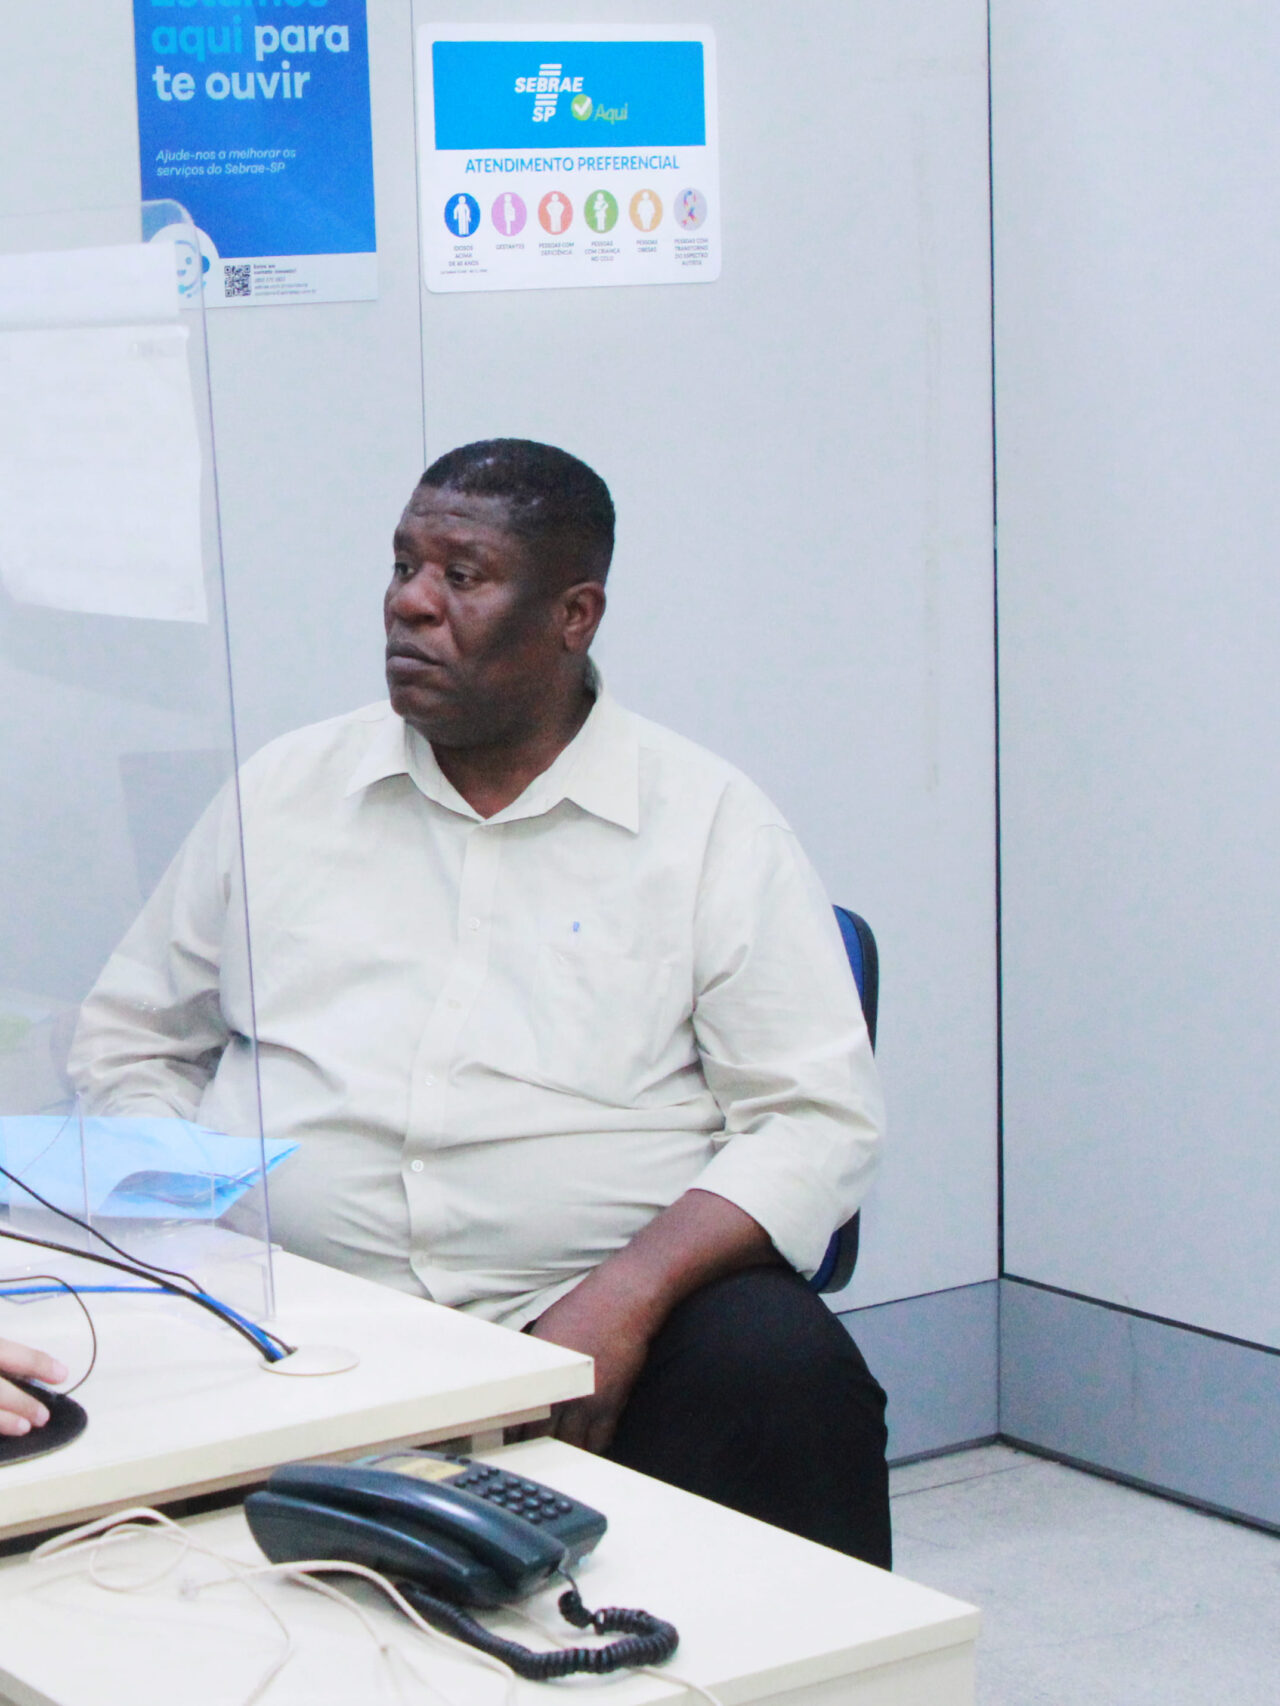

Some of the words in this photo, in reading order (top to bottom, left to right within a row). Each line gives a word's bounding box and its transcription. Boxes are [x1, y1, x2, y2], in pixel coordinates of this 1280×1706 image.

[152, 15, 242, 61] aqui
[255, 25, 349, 61] para
[152, 66, 195, 101] te
[206, 61, 310, 100] ouvir
[515, 77, 584, 93] SEBRAE
[532, 107, 556, 122] SP
[594, 103, 628, 124] Aqui
[156, 149, 216, 163] Ajude-nos
[219, 152, 226, 160] a
[228, 148, 281, 160] melhorar
[283, 149, 296, 159] os
[465, 157, 574, 173] ATENDIMENTO
[578, 155, 679, 171] PREFERENCIAL
[156, 163, 205, 177] serviços
[206, 163, 222, 175] do
[224, 162, 286, 175] Sebrae-SP
